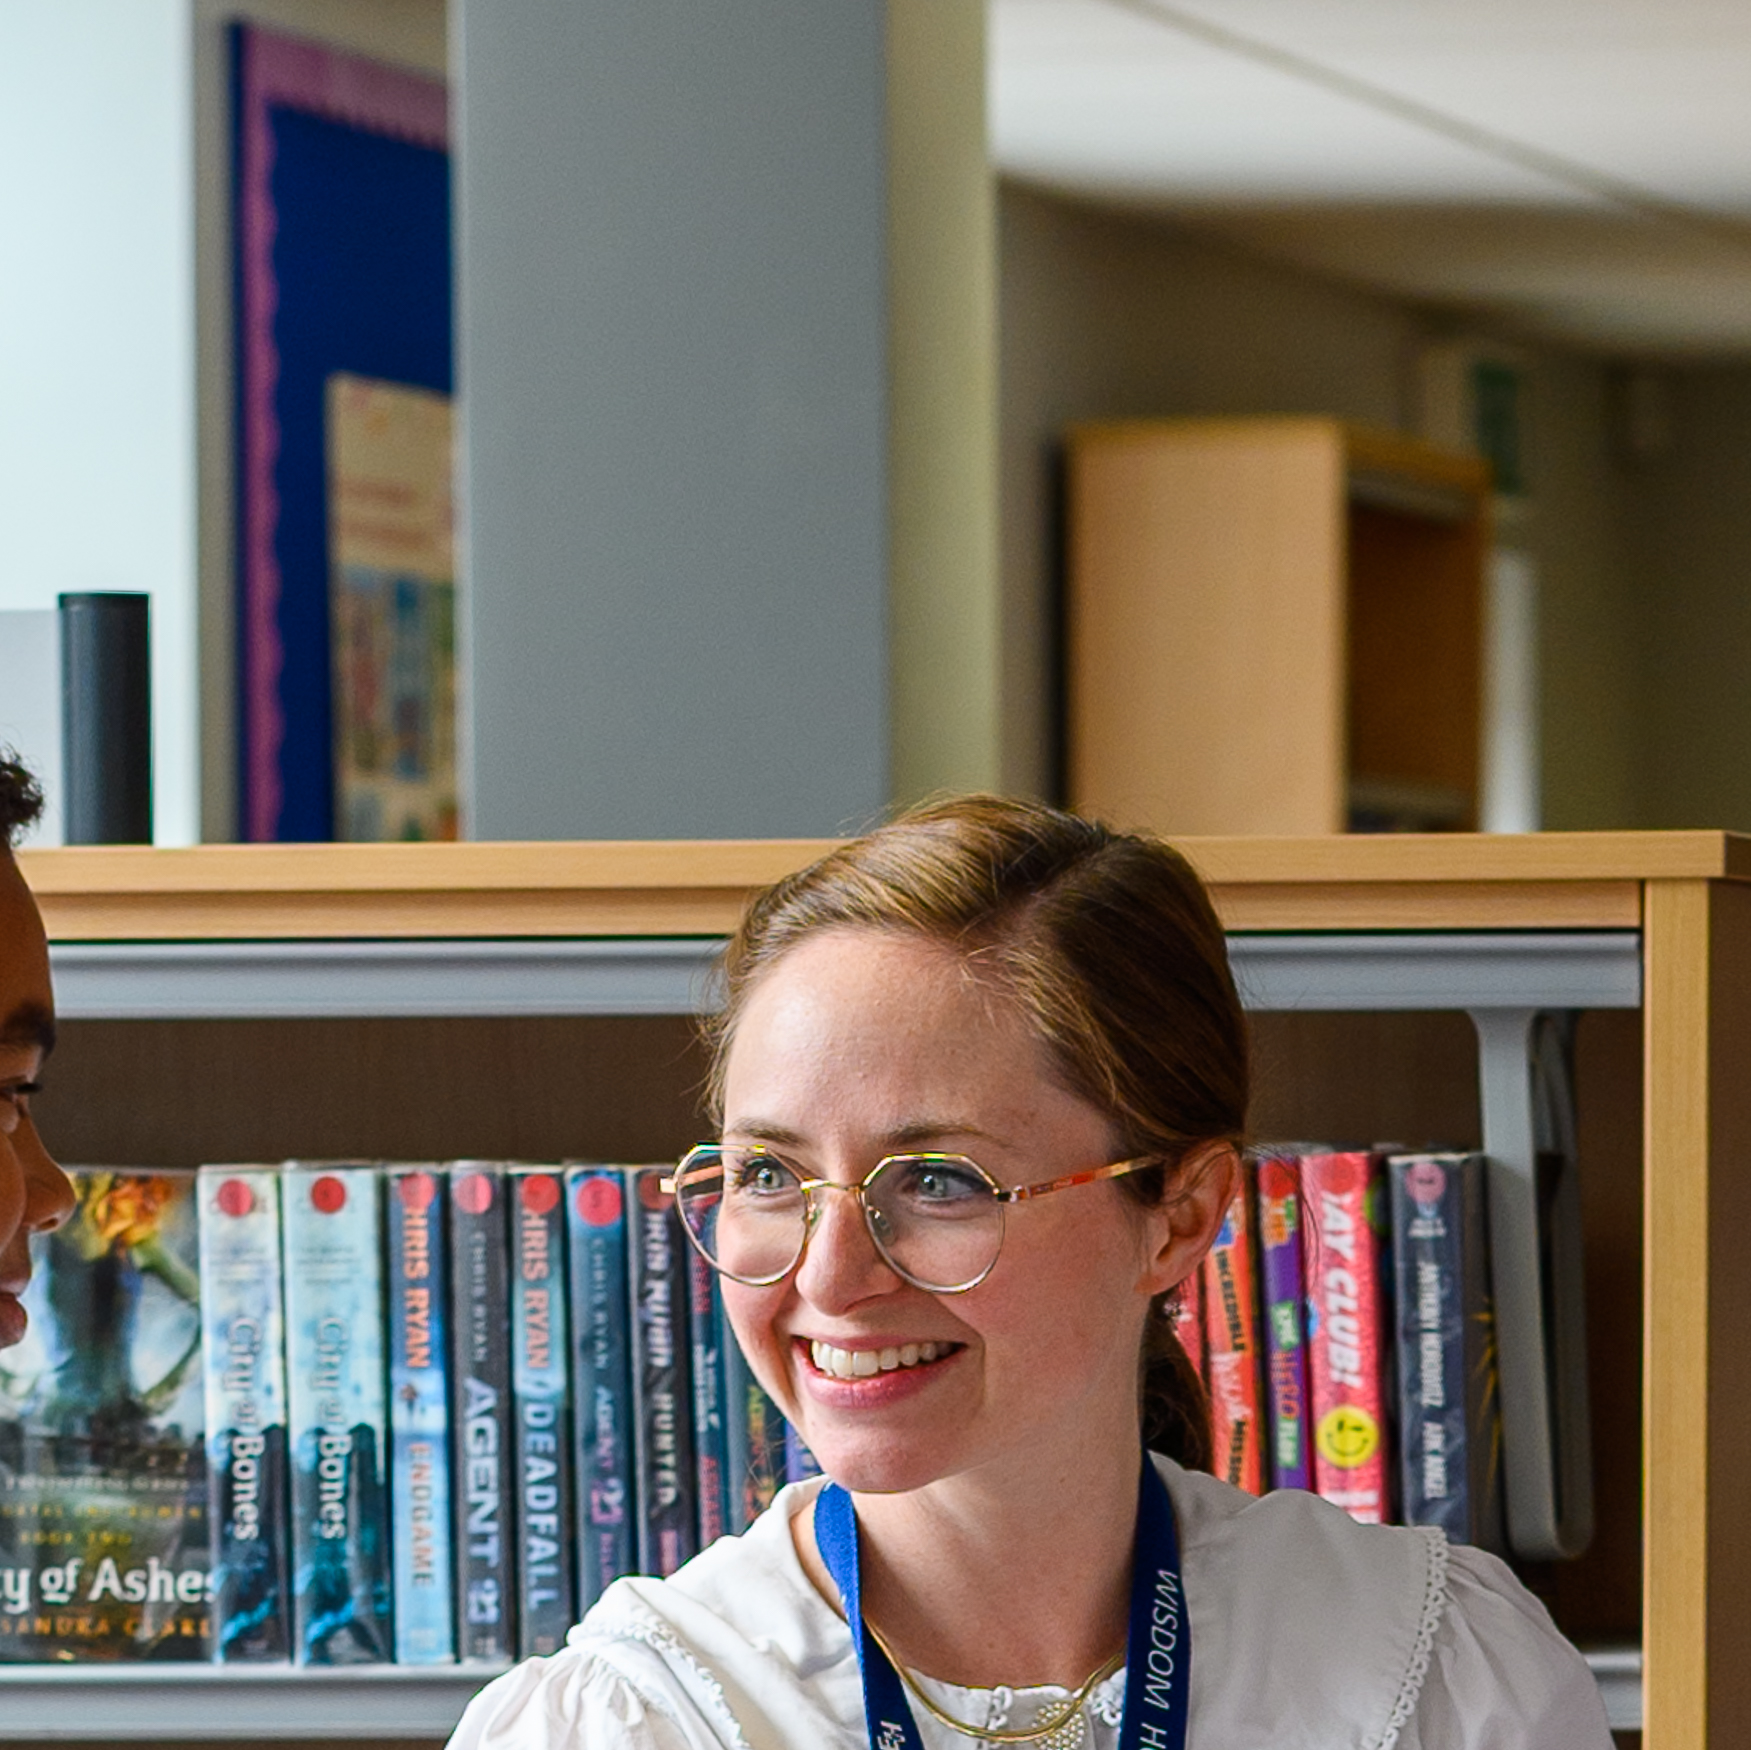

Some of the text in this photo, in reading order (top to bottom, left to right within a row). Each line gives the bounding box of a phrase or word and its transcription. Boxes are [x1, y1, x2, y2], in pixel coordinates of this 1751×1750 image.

[229, 1317, 265, 1395] City
[317, 1315, 347, 1388] City
[401, 1207, 431, 1368] HRIS RYAN
[521, 1207, 550, 1369] HRIS RYAN
[1321, 1191, 1363, 1390] AY CLUB!
[230, 1432, 265, 1541] Bones
[318, 1432, 352, 1540] Bones
[464, 1377, 499, 1568] AGENT
[594, 1386, 623, 1472] AGENT
[408, 1442, 434, 1587] ENDGAME
[524, 1403, 559, 1611] DEADFALL
[39, 1557, 85, 1604] of
[1142, 1567, 1179, 1711] WISDOM
